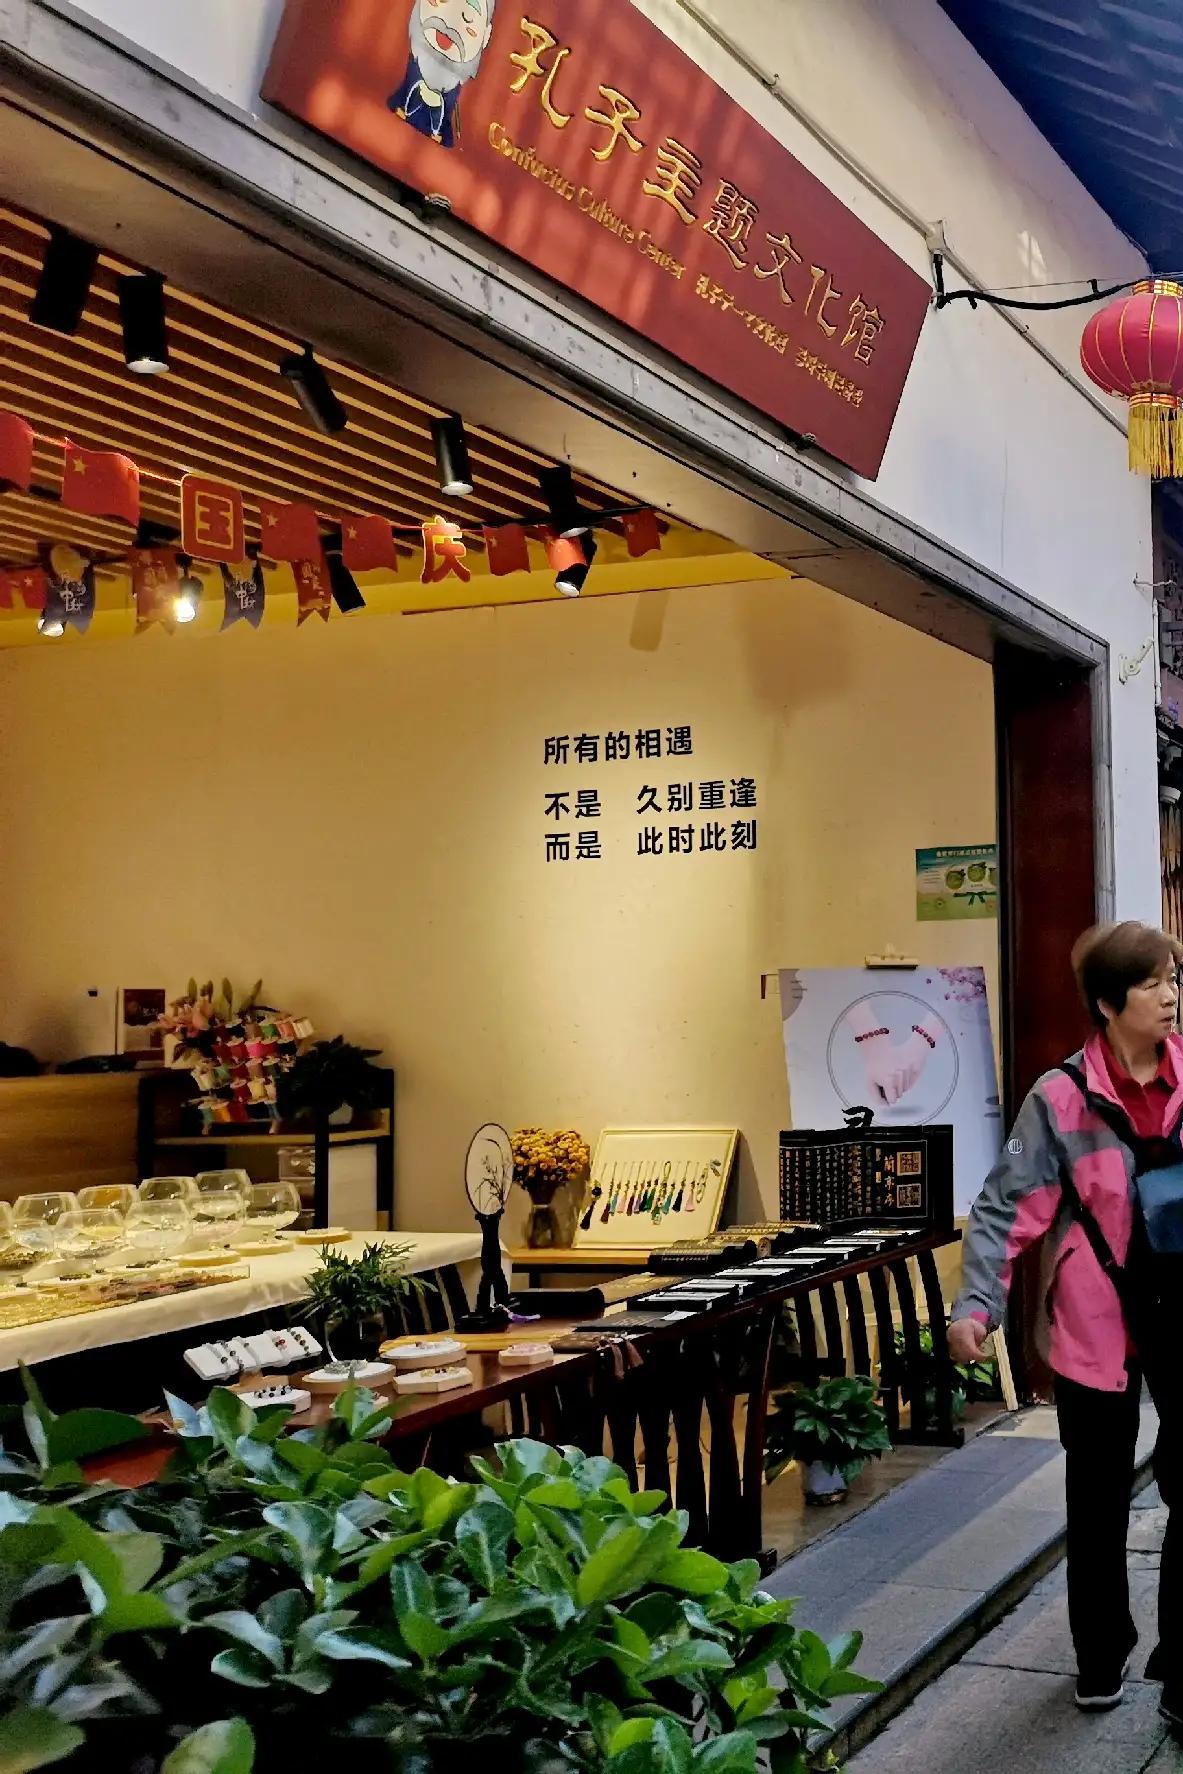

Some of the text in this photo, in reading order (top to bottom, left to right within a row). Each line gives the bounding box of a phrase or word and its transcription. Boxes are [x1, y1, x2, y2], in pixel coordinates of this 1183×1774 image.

[488, 121, 687, 280] Confucius Culture Center
[509, 17, 887, 365] 孔子主题文化馆
[420, 514, 471, 584] 庆
[544, 725, 693, 765] 所有的相遇
[544, 777, 757, 821] 不是 久别重逢
[544, 819, 757, 862] 而是 此时此刻
